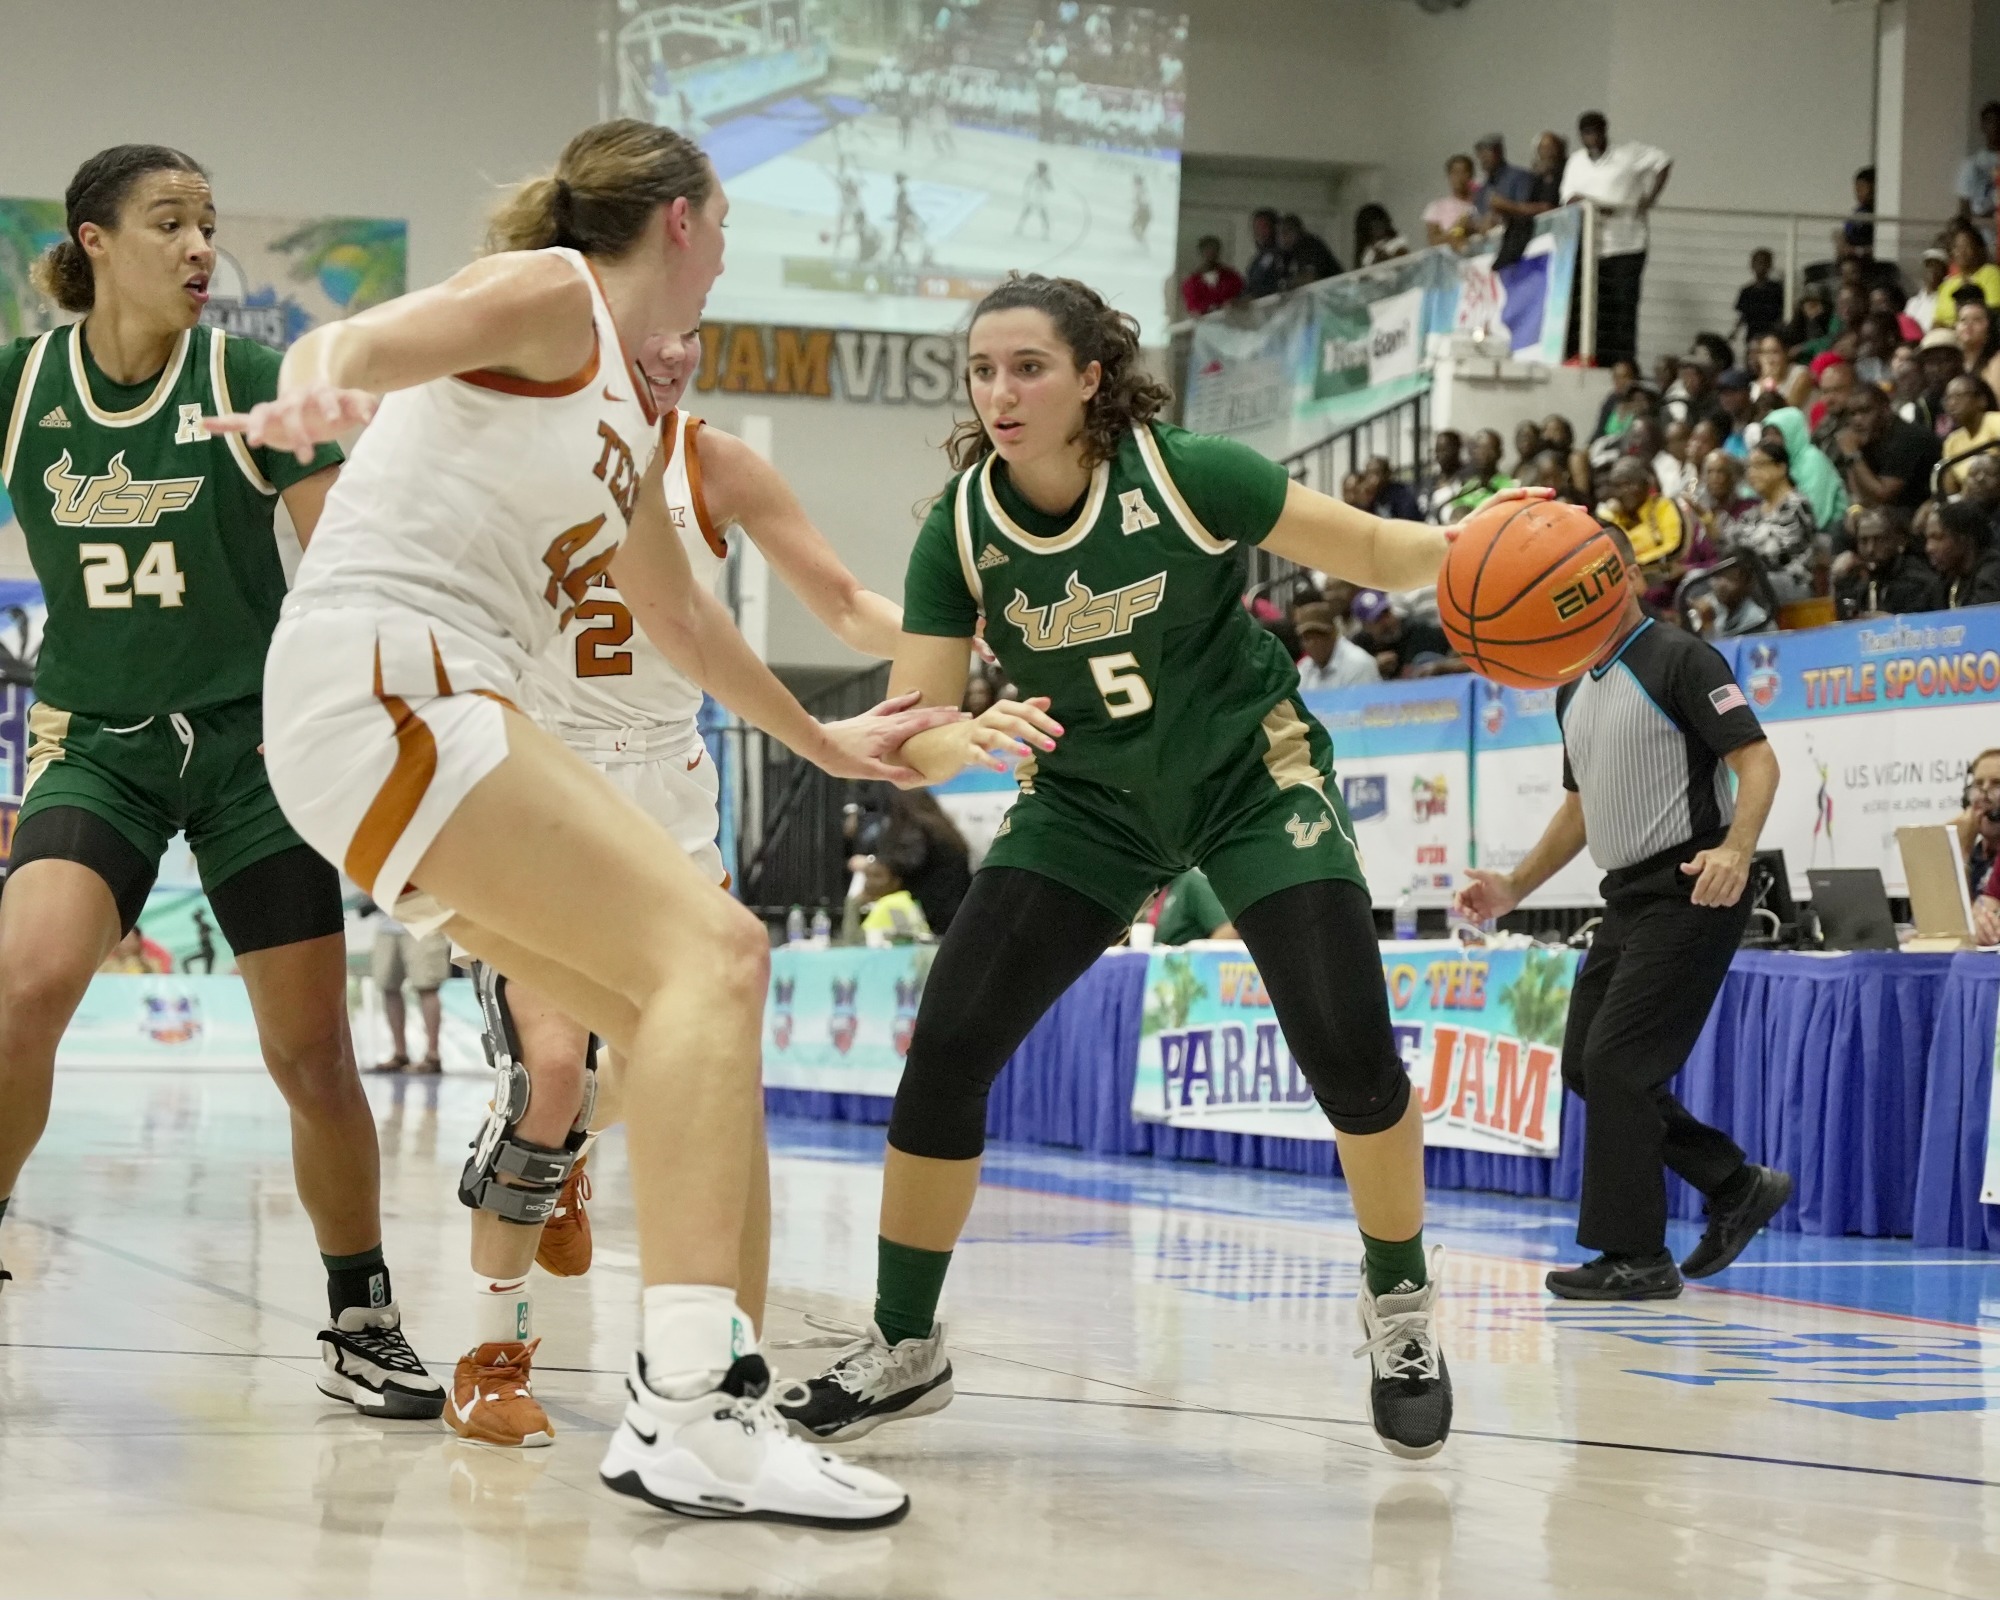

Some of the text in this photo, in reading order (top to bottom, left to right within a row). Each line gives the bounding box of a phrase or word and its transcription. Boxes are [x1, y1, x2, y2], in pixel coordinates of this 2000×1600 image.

[39, 417, 72, 429] adidas
[43, 448, 205, 528] USF
[79, 541, 186, 609] 24
[977, 553, 1010, 570] adidas
[1552, 552, 1626, 621] ELITE
[574, 598, 634, 679] 2
[1004, 569, 1167, 651] USF
[1087, 651, 1153, 719] 5
[1803, 649, 2000, 709] TITLE SPONSO
[1844, 764, 1869, 789] US
[1425, 959, 1490, 1012] THE
[1422, 1026, 1557, 1143] JAM
